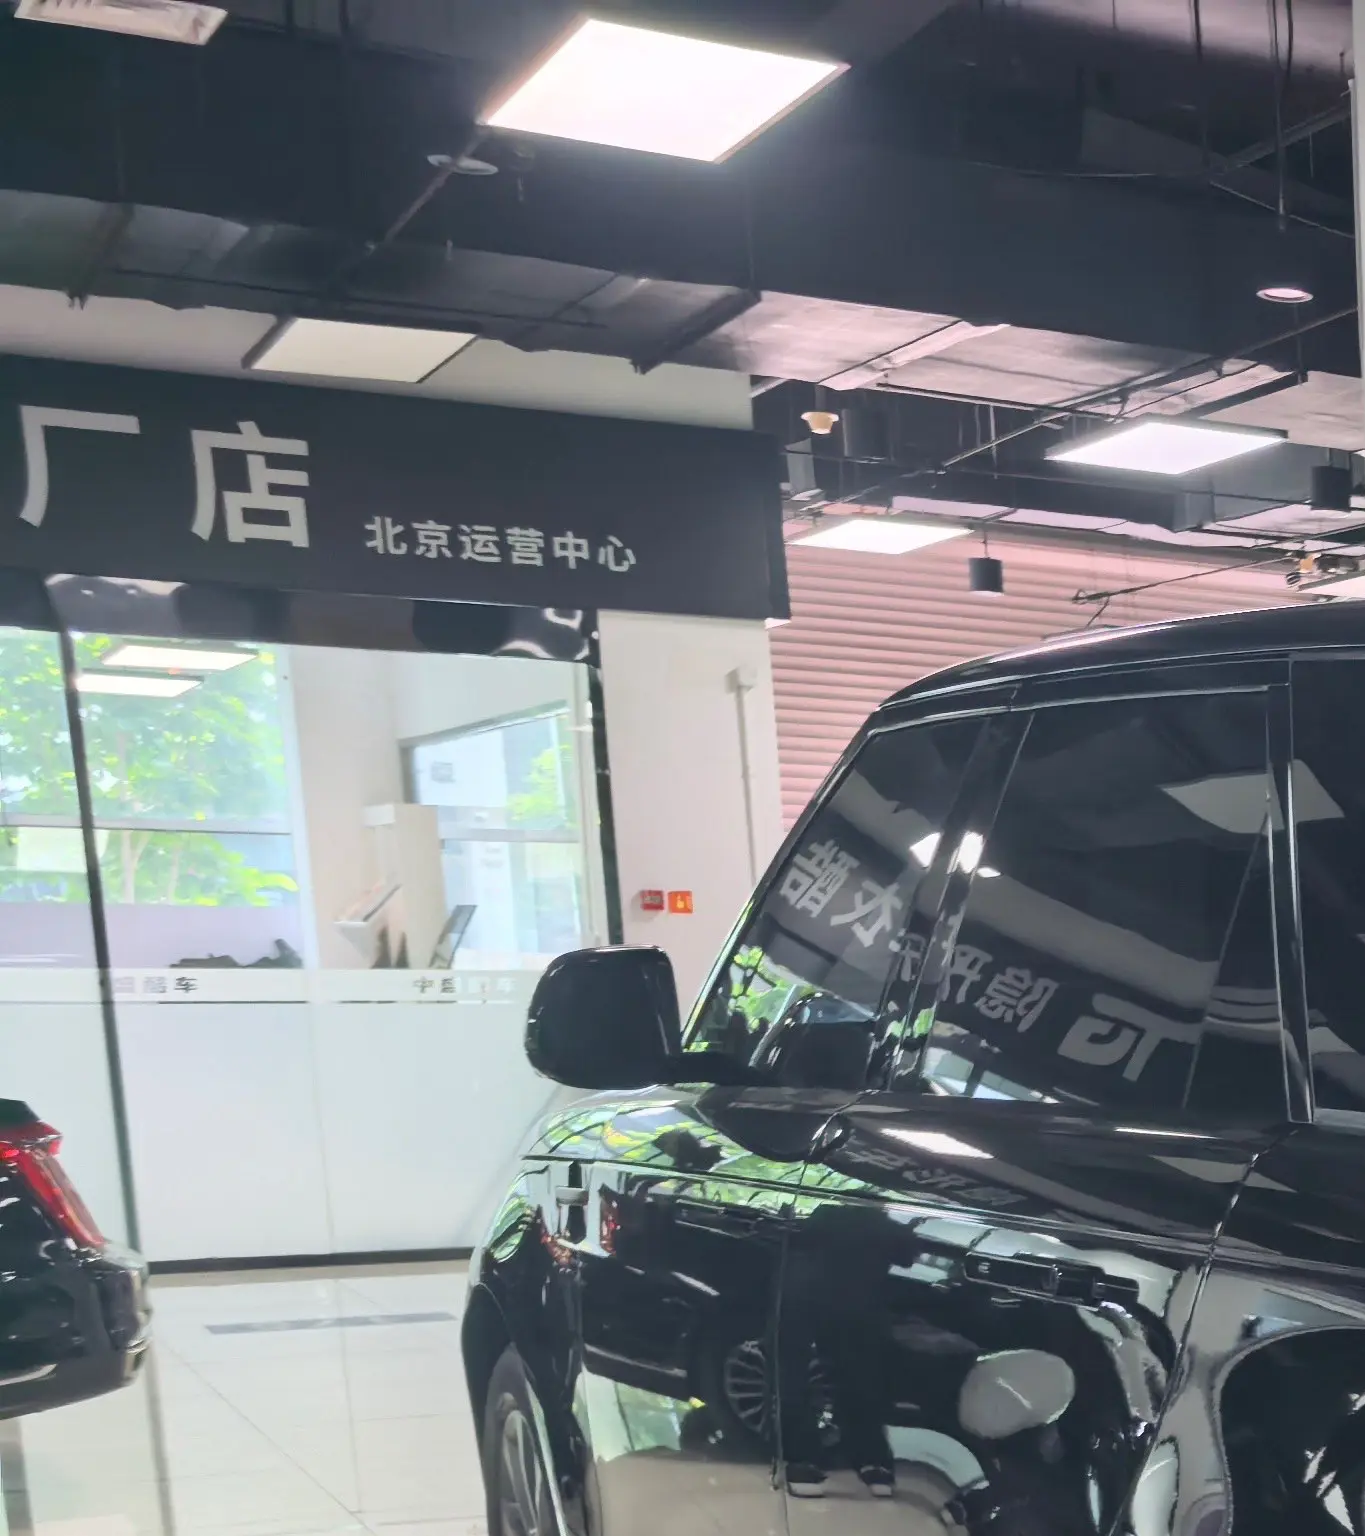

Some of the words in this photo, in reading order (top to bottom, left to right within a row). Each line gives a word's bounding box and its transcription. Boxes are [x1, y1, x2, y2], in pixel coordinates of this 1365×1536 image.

[18, 404, 310, 548] 厂店
[364, 515, 637, 573] 北京运营中心
